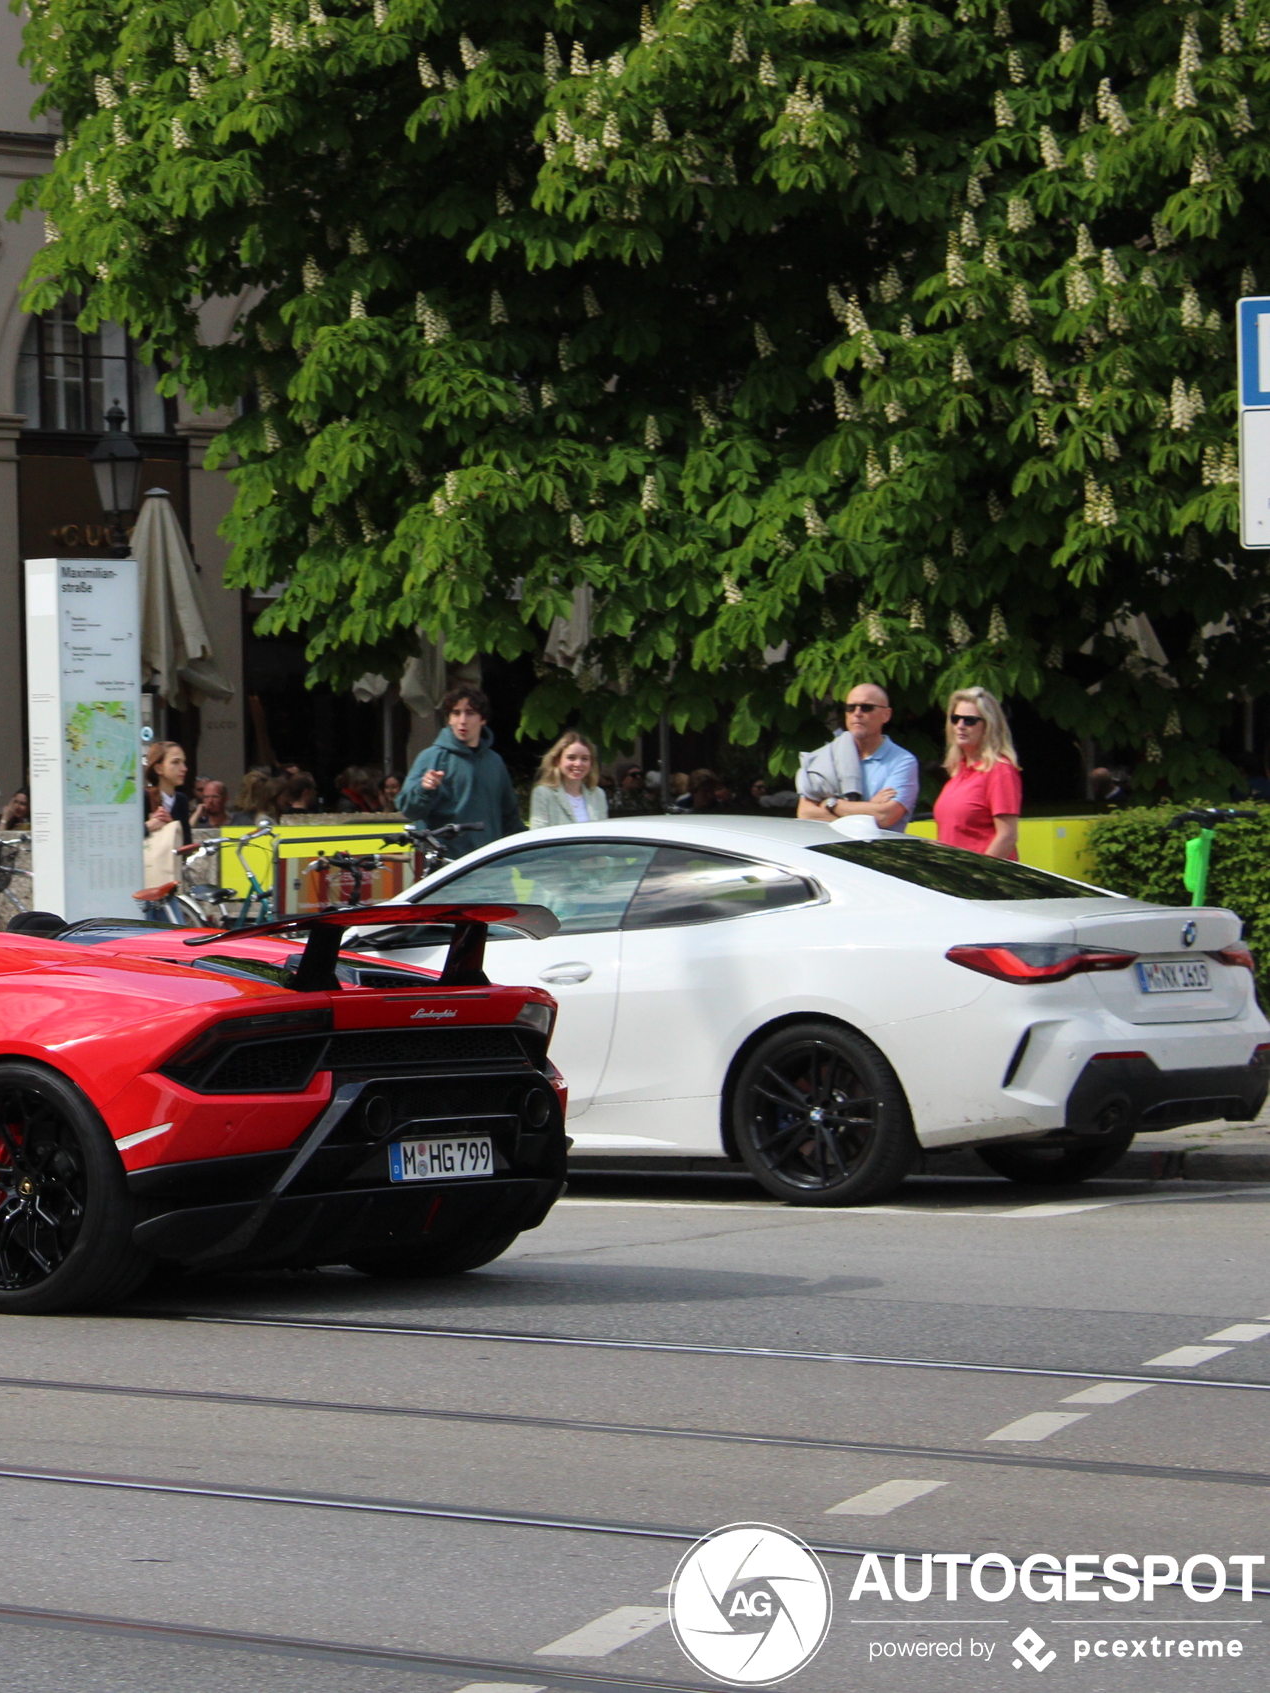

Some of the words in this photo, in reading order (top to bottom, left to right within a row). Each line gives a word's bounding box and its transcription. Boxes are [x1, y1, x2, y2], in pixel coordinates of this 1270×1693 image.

[61, 567, 118, 579] Maximilian-
[61, 582, 93, 593] straße
[1160, 965, 1180, 988] NX
[403, 1145, 417, 1175] M
[429, 1143, 455, 1173] HG
[457, 1141, 490, 1171] 799
